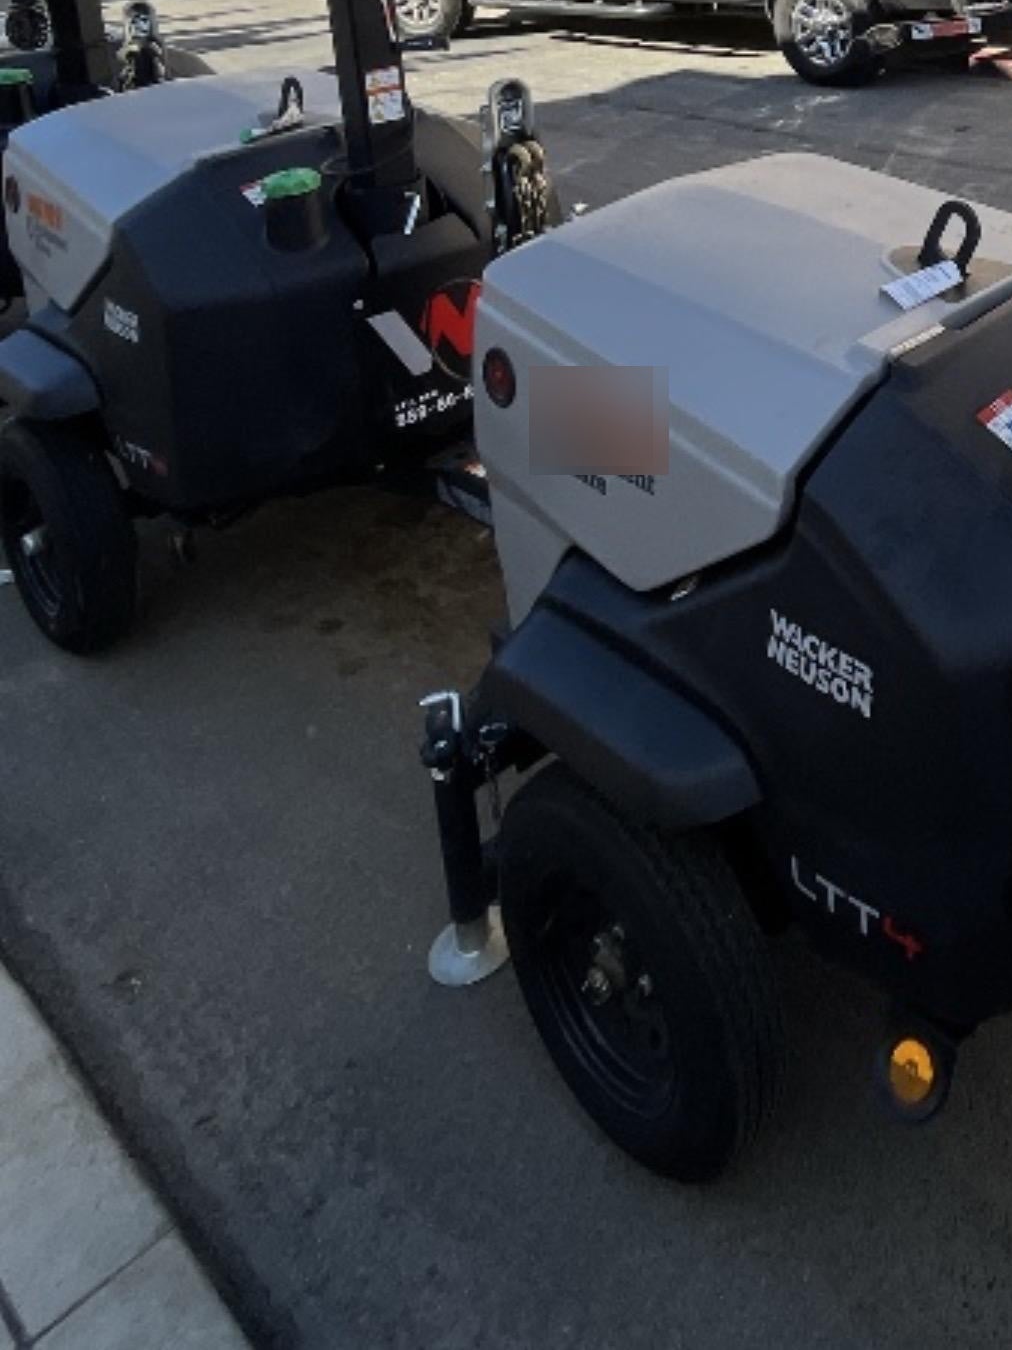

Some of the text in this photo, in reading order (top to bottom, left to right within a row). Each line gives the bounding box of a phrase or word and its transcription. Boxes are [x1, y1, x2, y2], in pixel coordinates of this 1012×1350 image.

[766, 634, 874, 718] NEUSON
[769, 608, 873, 693] WACKER
[790, 853, 925, 962] LTT4
